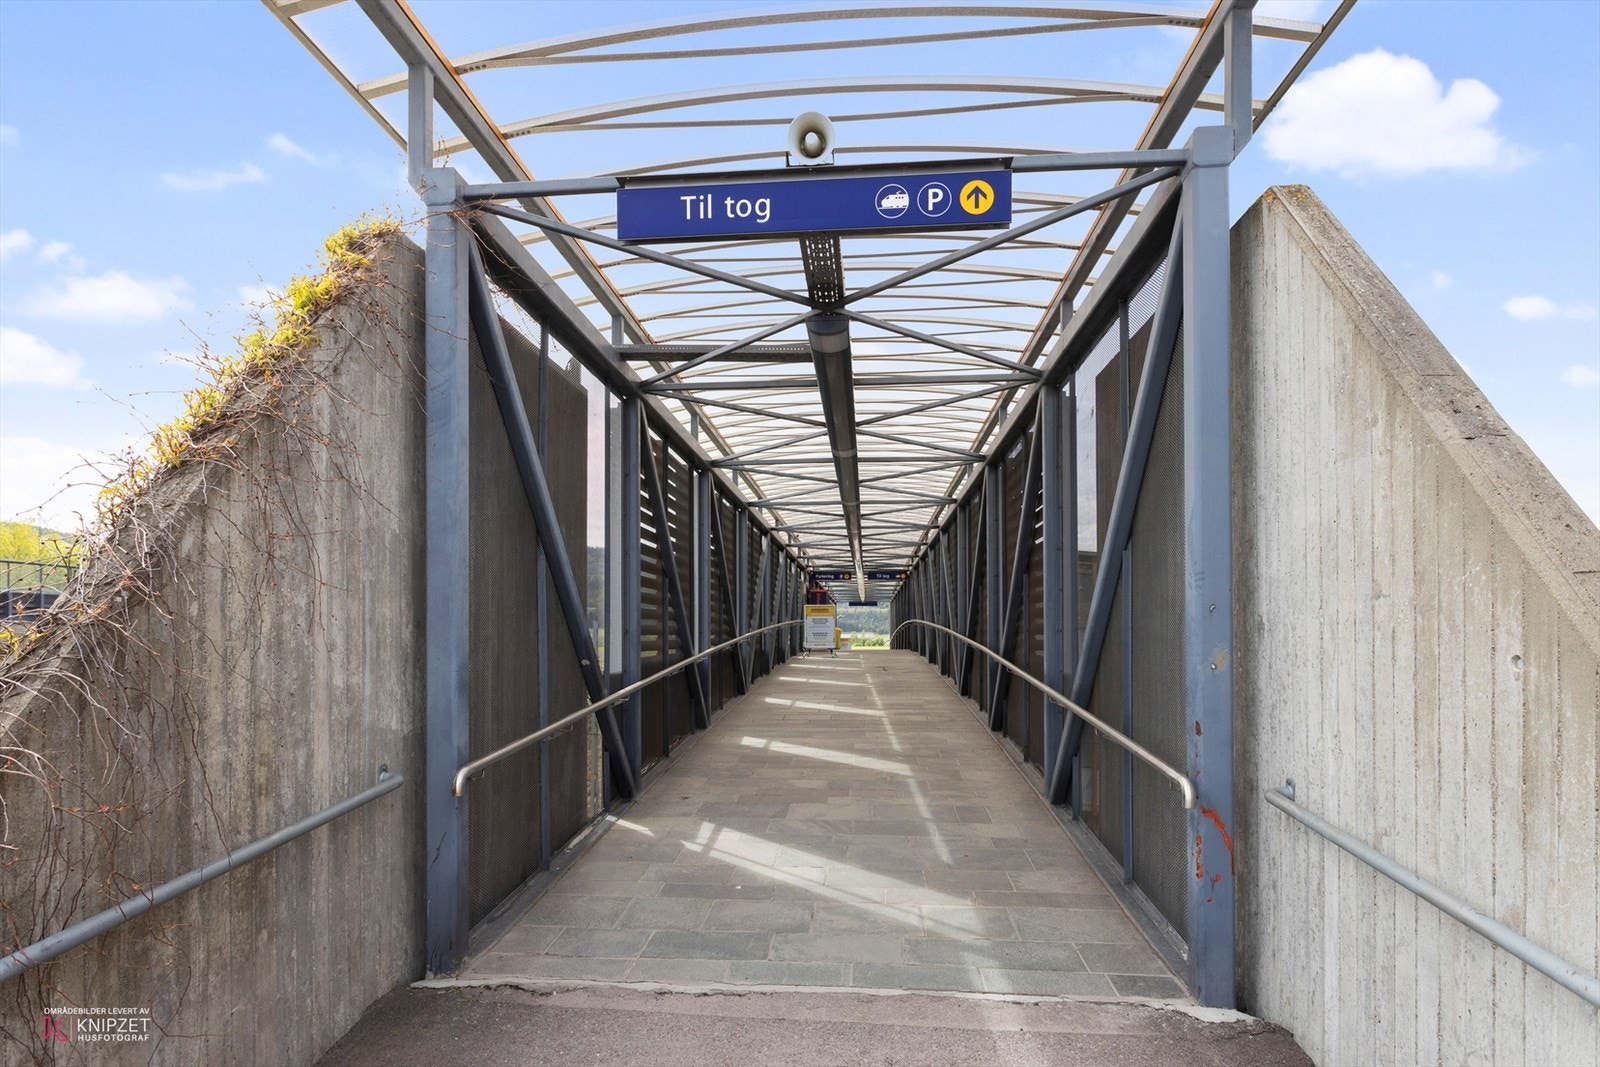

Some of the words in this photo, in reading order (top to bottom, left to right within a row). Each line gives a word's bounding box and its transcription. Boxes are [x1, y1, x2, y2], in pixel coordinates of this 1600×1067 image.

[680, 194, 712, 221] Til
[725, 195, 771, 223] tog
[927, 188, 944, 211] P
